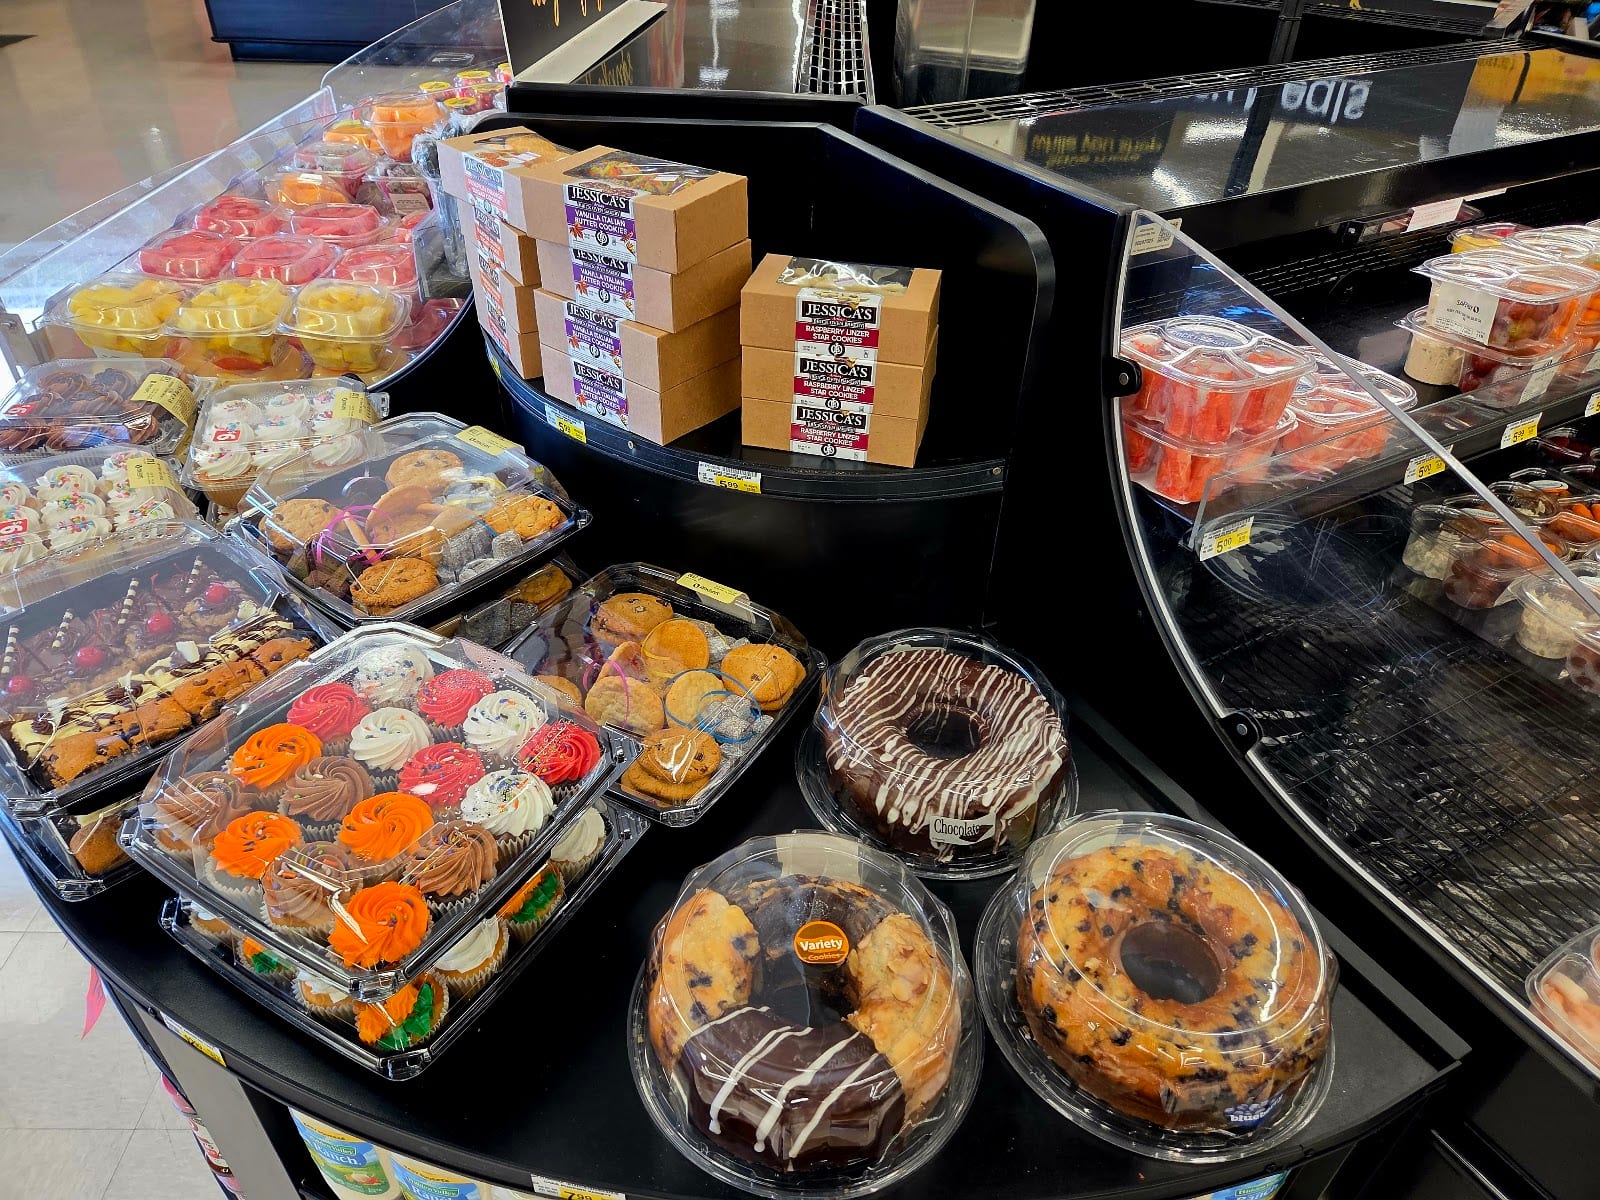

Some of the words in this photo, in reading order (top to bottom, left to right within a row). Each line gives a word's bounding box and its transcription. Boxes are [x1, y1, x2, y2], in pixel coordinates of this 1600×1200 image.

[572, 186, 626, 209] JESSICA'S
[575, 208, 601, 221] VANILLA
[602, 215, 626, 228] ITALIAN
[575, 216, 598, 228] BUTTER
[599, 222, 628, 235] COOKIES
[577, 249, 625, 270] JESSICA'S
[570, 303, 614, 329] JESSICA'S
[805, 303, 873, 320] JESSICA'S
[805, 324, 845, 336] RASPBERRY
[846, 328, 870, 338] LINZER
[812, 332, 830, 341] STAR
[831, 335, 863, 344] COOKIES
[577, 364, 620, 390] JESSICA'S
[803, 360, 868, 378] JESSICA'S
[803, 380, 842, 391] RASPBERRY
[842, 385, 866, 394] LINZER
[810, 388, 827, 396] STAR
[828, 391, 858, 400] COOKIES
[800, 408, 862, 426] JESSICA'S
[800, 427, 837, 438] RASPBERRY
[837, 432, 860, 442] LINZER
[806, 434, 823, 442] STAR
[823, 437, 853, 447] COOKIES
[934, 818, 980, 837] Chocolate
[800, 938, 843, 951] Variety
